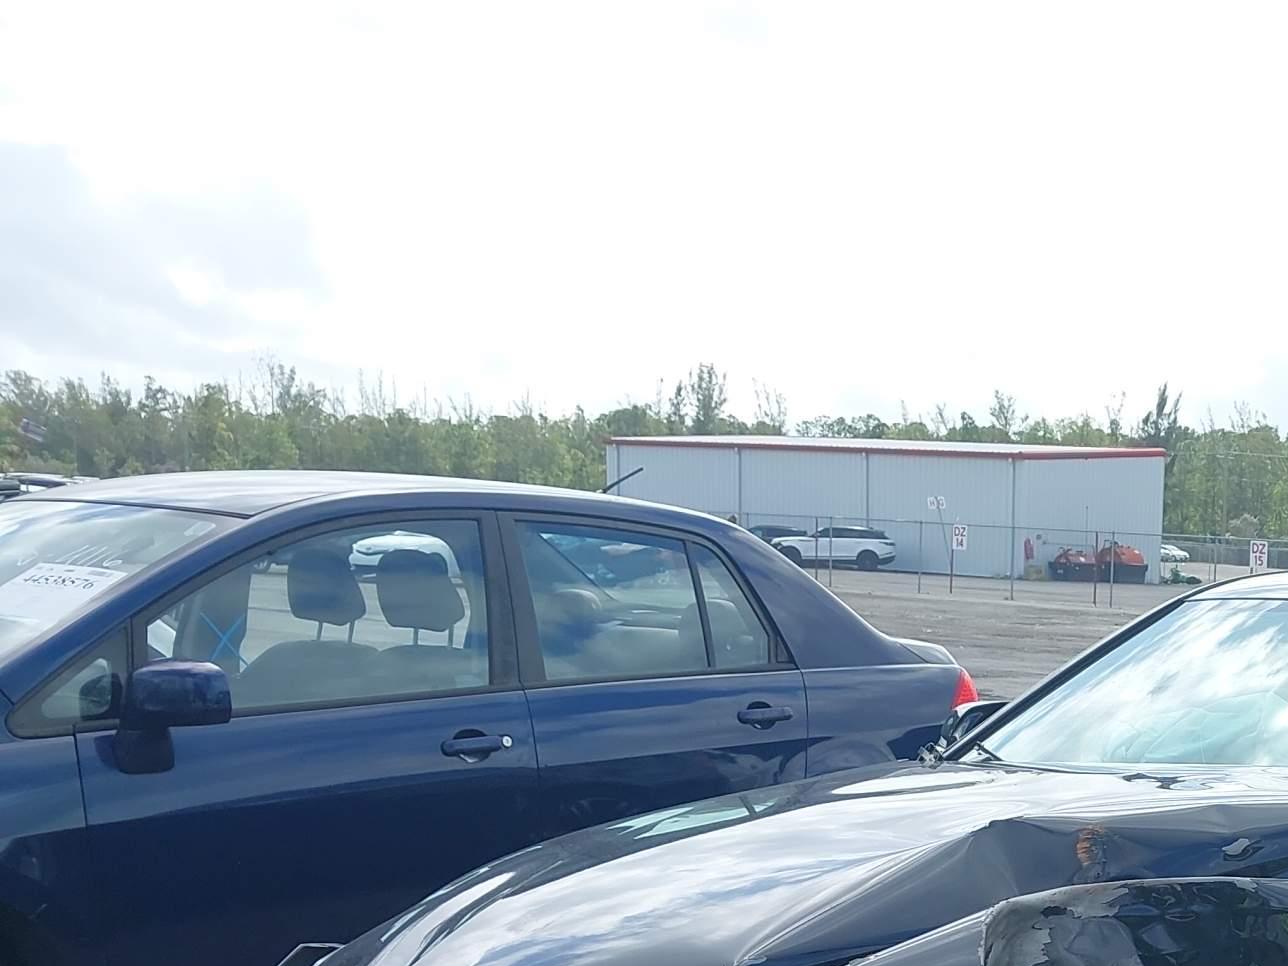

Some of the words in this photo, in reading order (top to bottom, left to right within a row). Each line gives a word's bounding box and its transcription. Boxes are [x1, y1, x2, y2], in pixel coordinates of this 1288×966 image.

[954, 526, 966, 537] DZ
[956, 538, 964, 547] 14
[1252, 542, 1266, 555] DZ
[1254, 555, 1264, 566] 15
